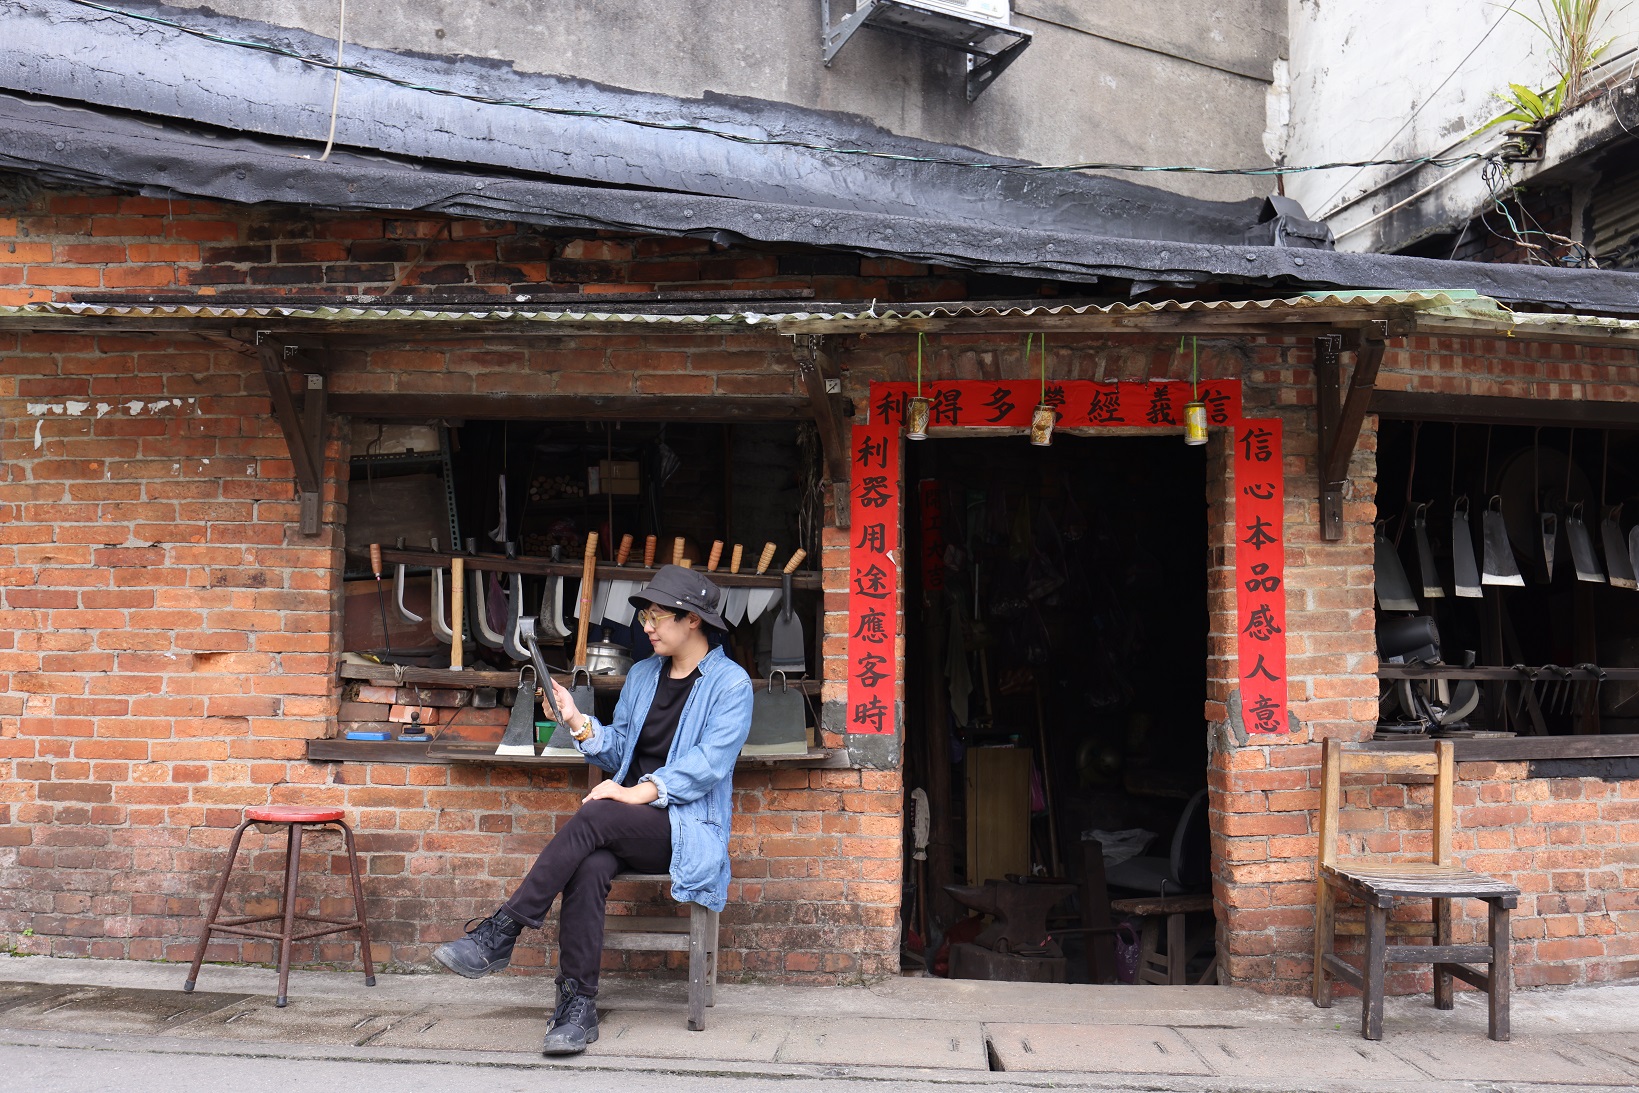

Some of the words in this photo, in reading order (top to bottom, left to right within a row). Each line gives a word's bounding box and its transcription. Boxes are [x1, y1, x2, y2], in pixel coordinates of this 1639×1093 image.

[851, 435, 894, 732] 利器用途應客時
[1239, 427, 1282, 733] 信心本品感人意
